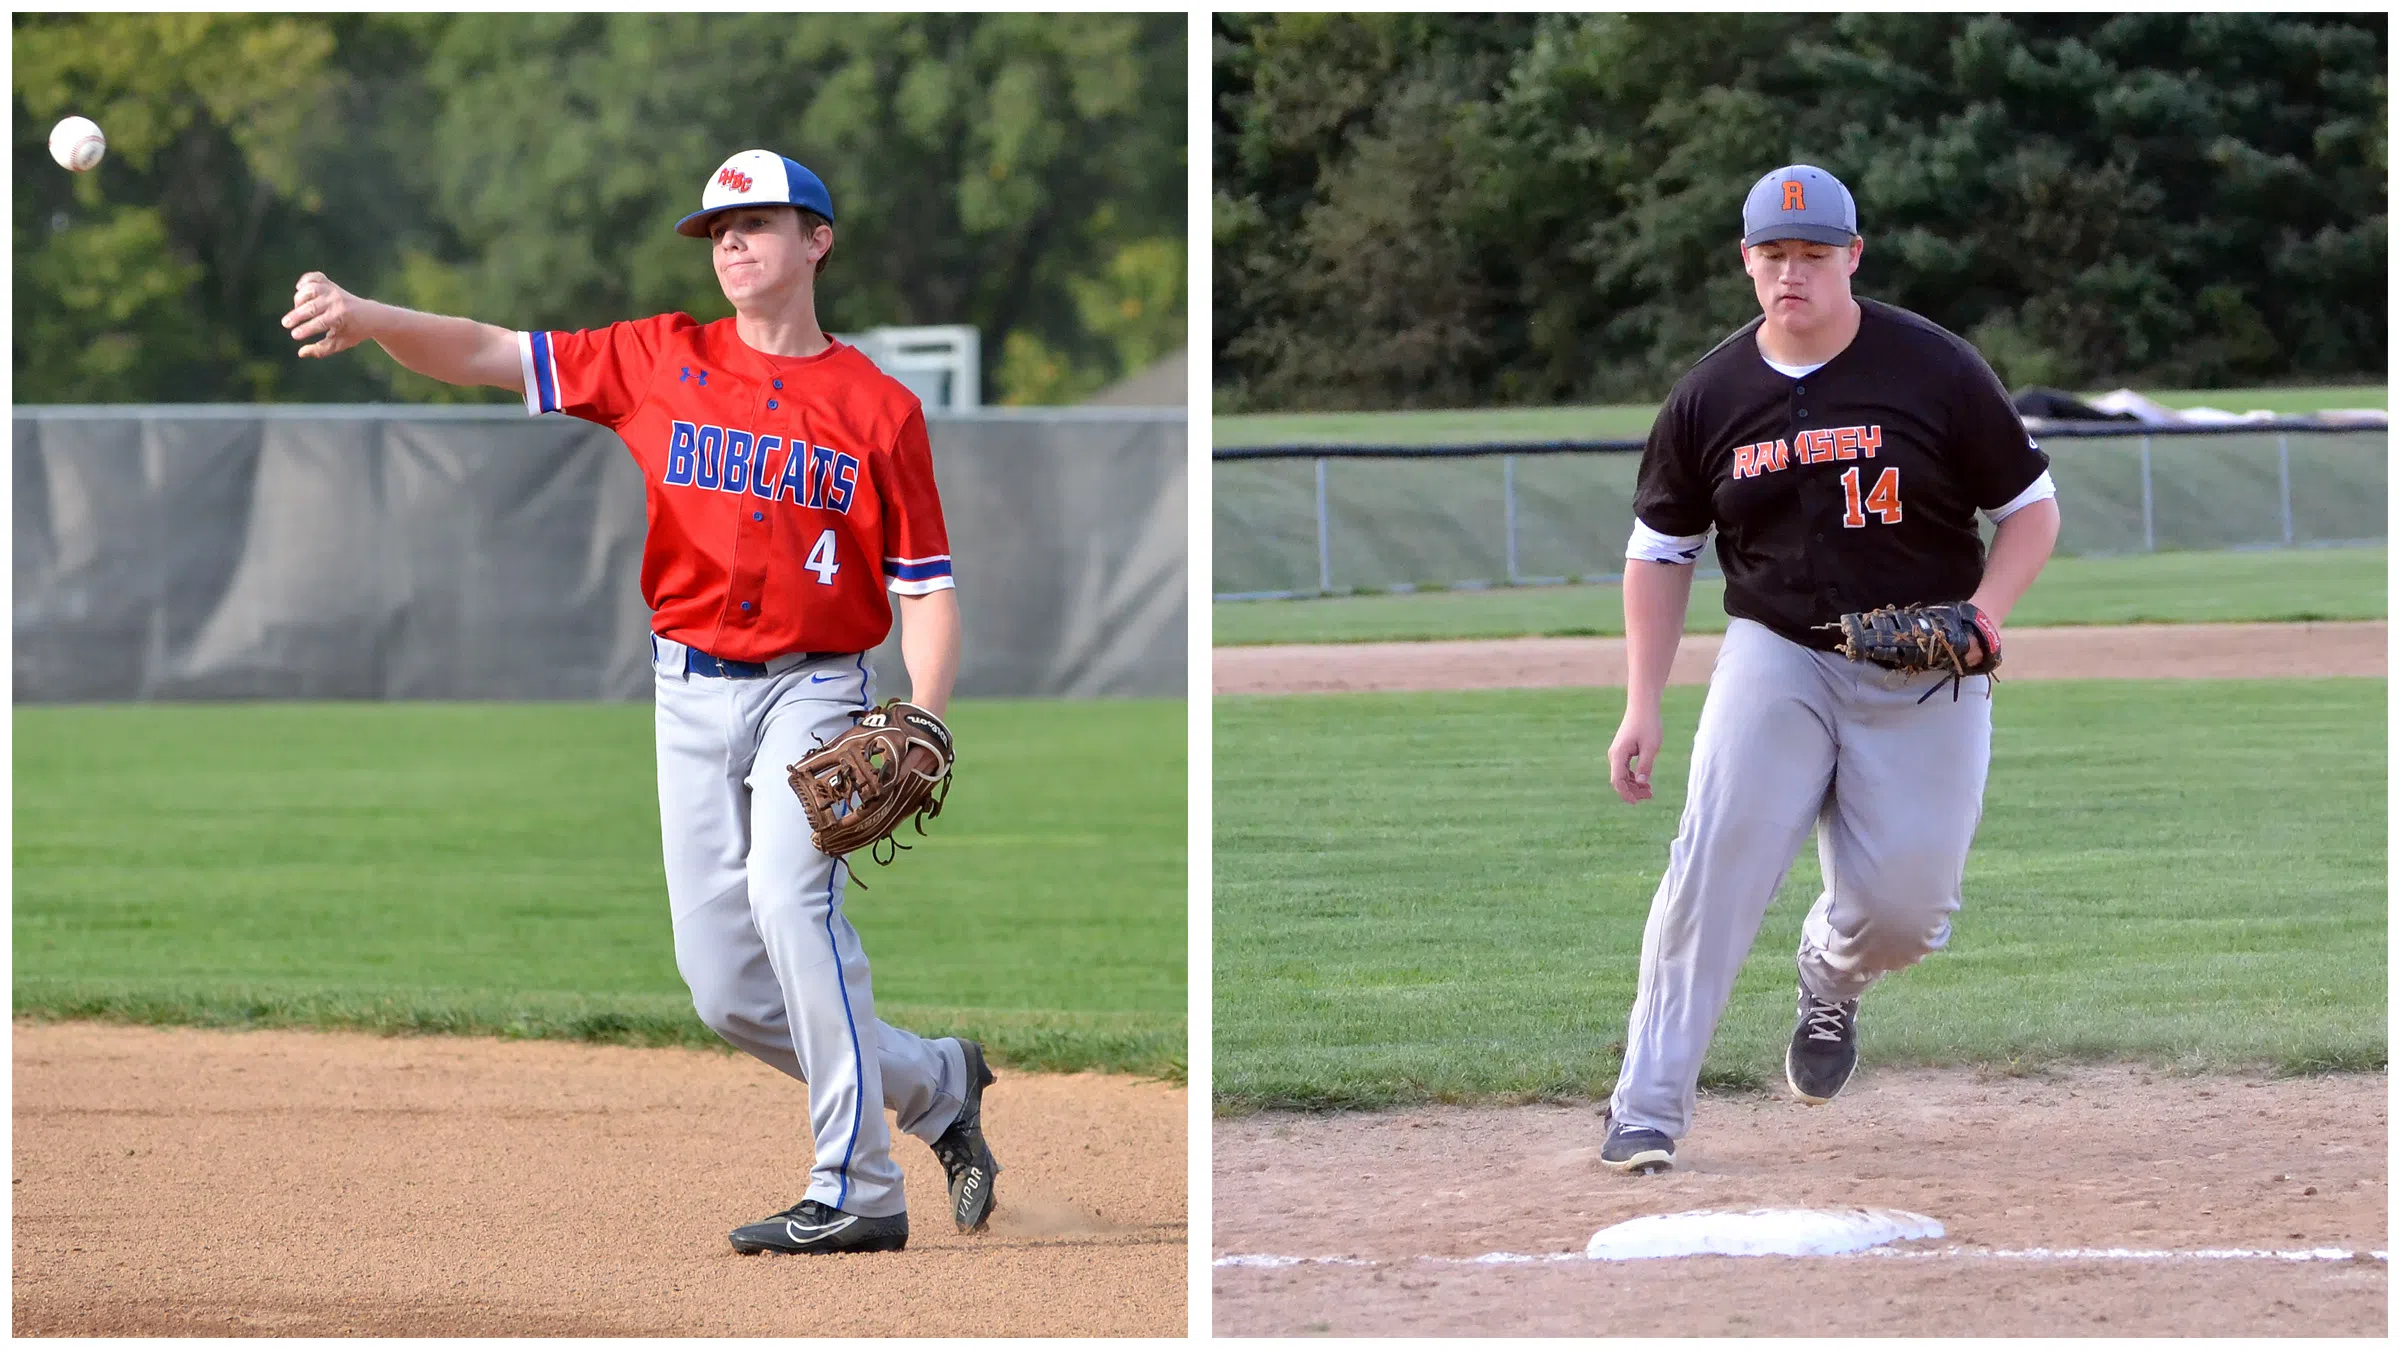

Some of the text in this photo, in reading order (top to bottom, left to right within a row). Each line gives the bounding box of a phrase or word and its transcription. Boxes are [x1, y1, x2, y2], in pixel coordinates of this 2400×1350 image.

[1782, 181, 1806, 211] R
[664, 420, 860, 515] BOBCATS
[1733, 425, 1882, 480] RAMSEY
[1840, 467, 1902, 528] 14
[803, 528, 841, 587] 4
[958, 1166, 983, 1218] VAPOR
